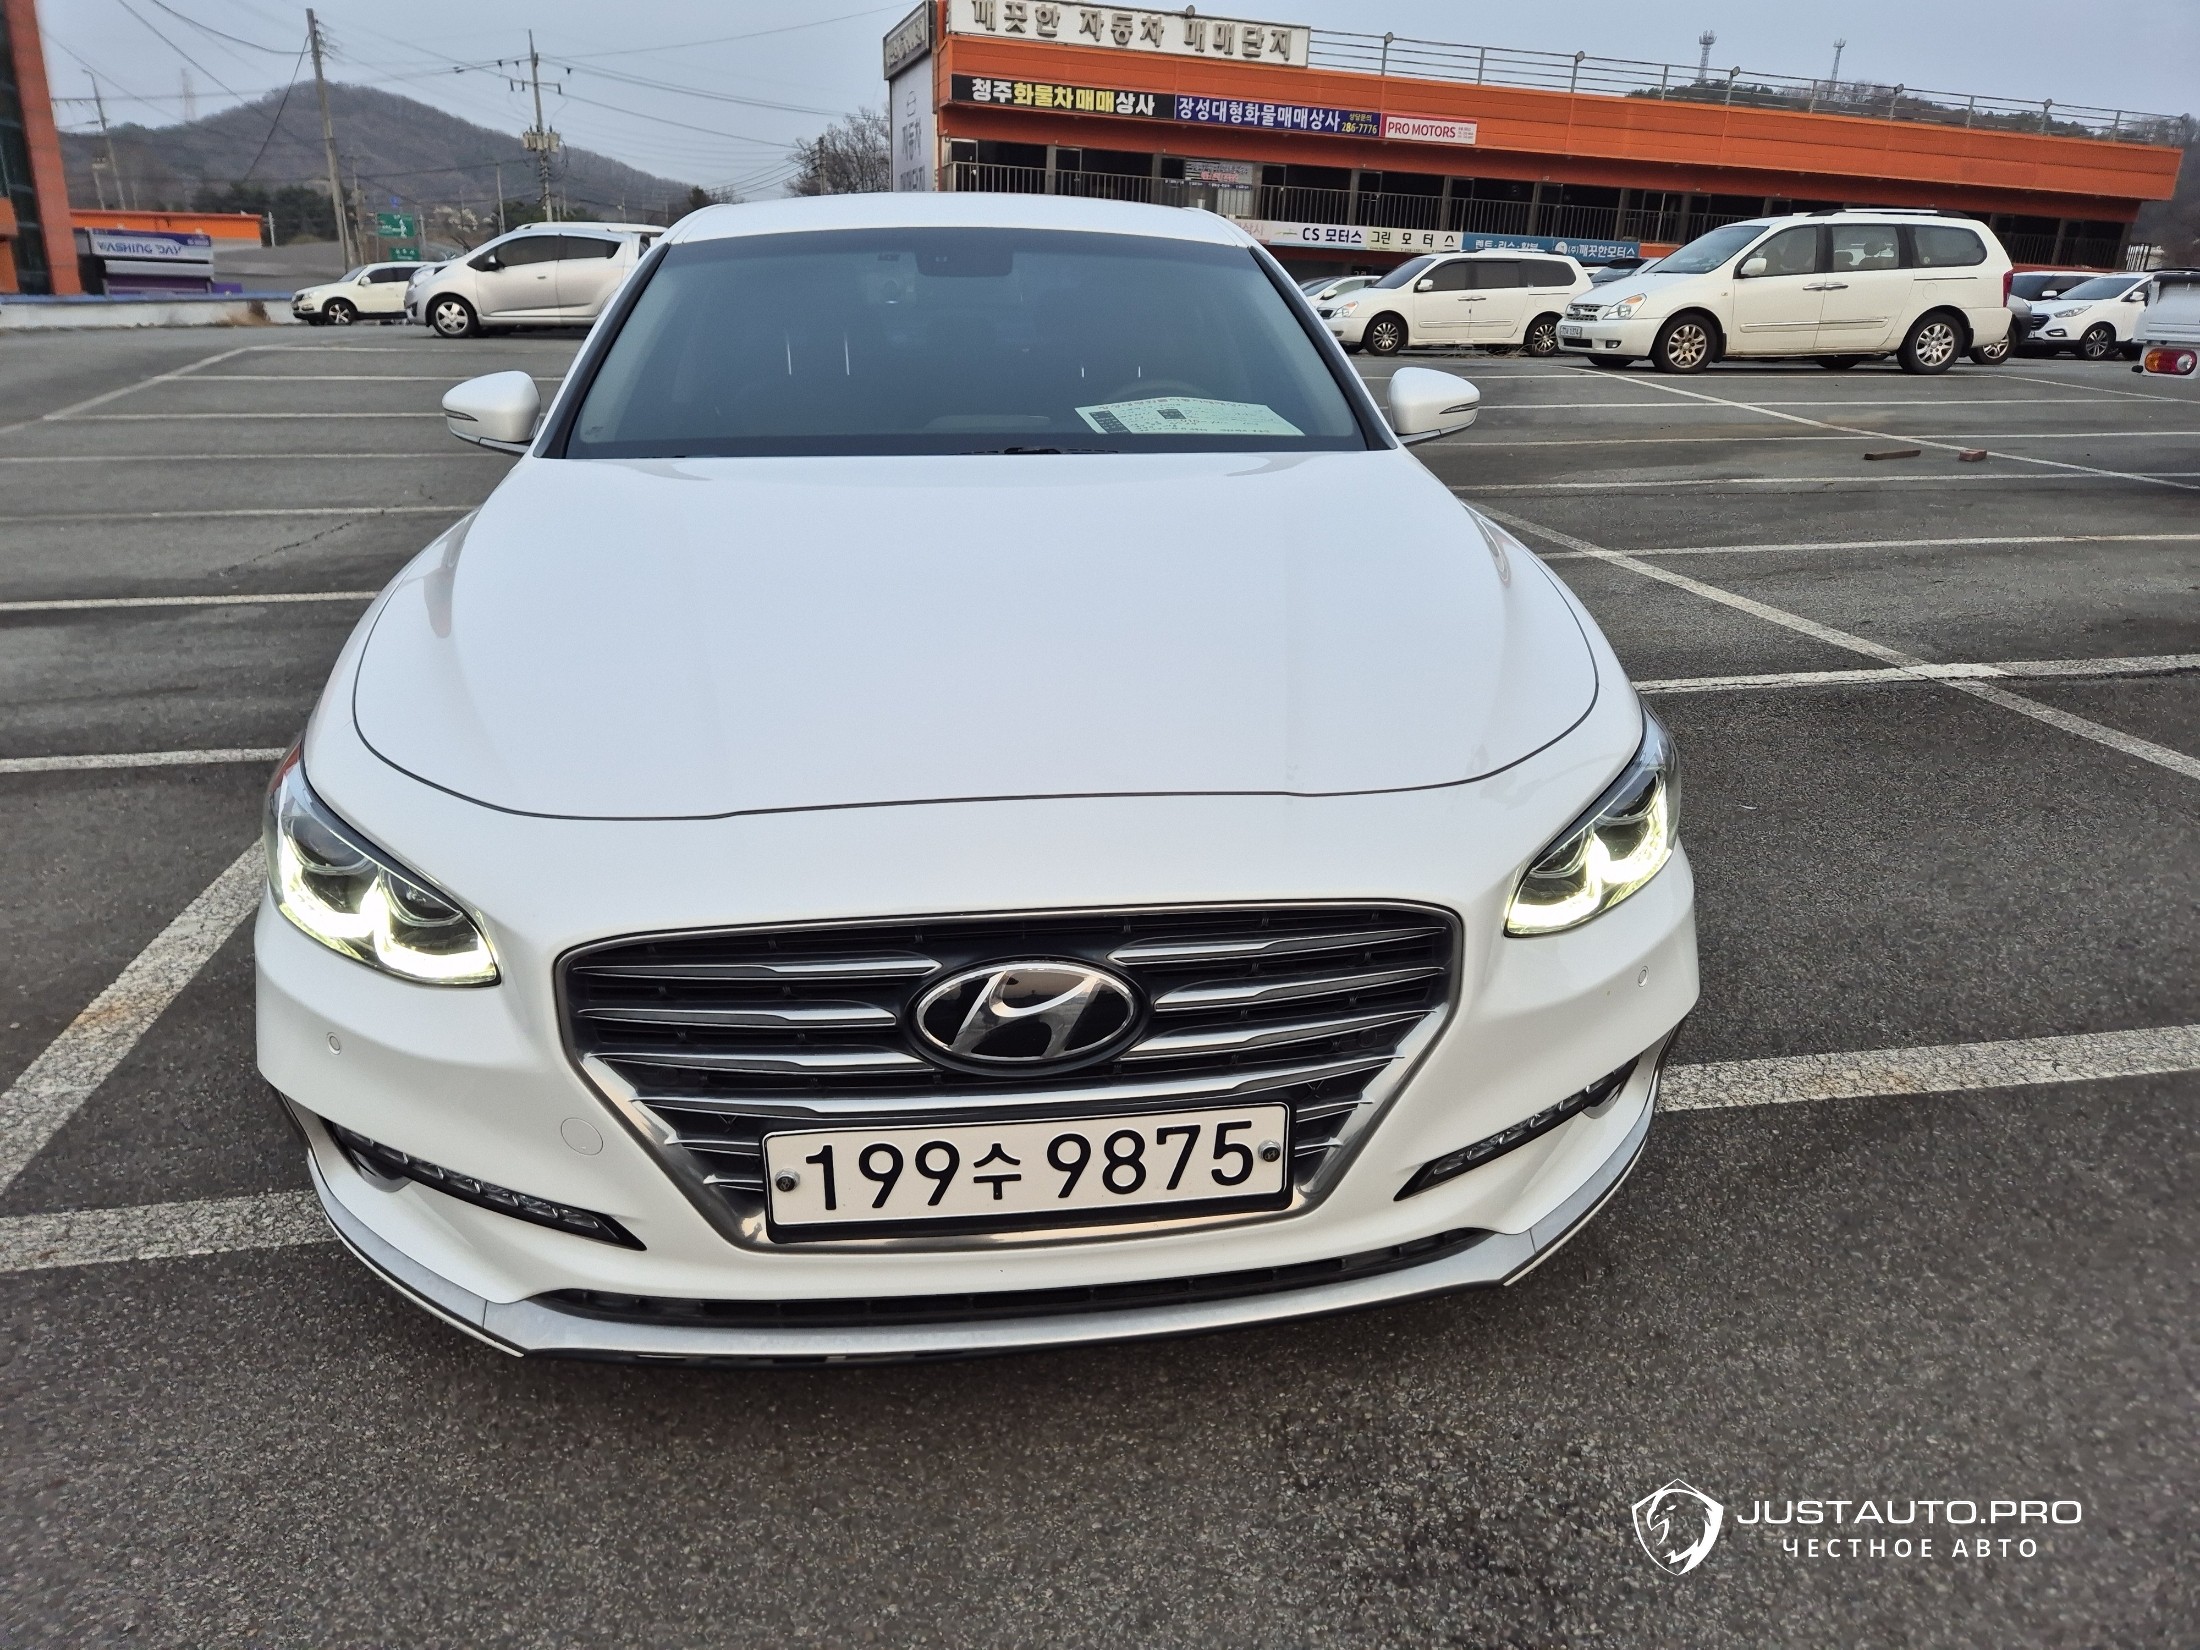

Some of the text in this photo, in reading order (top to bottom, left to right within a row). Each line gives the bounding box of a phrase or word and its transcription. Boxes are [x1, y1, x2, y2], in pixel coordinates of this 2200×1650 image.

[1079, 9, 1165, 48] 자동차
[1183, 19, 1292, 61] 매매단지
[972, 78, 1155, 116] 청주화물차매매상사
[1178, 97, 1341, 132] 장성대형화물매매상사
[1341, 122, 1378, 134] 286-7776
[1387, 121, 1410, 134] PRO
[1411, 123, 1456, 138] MOTORS
[1302, 227, 1362, 243] CS 모터스
[1370, 231, 1391, 245] 그린
